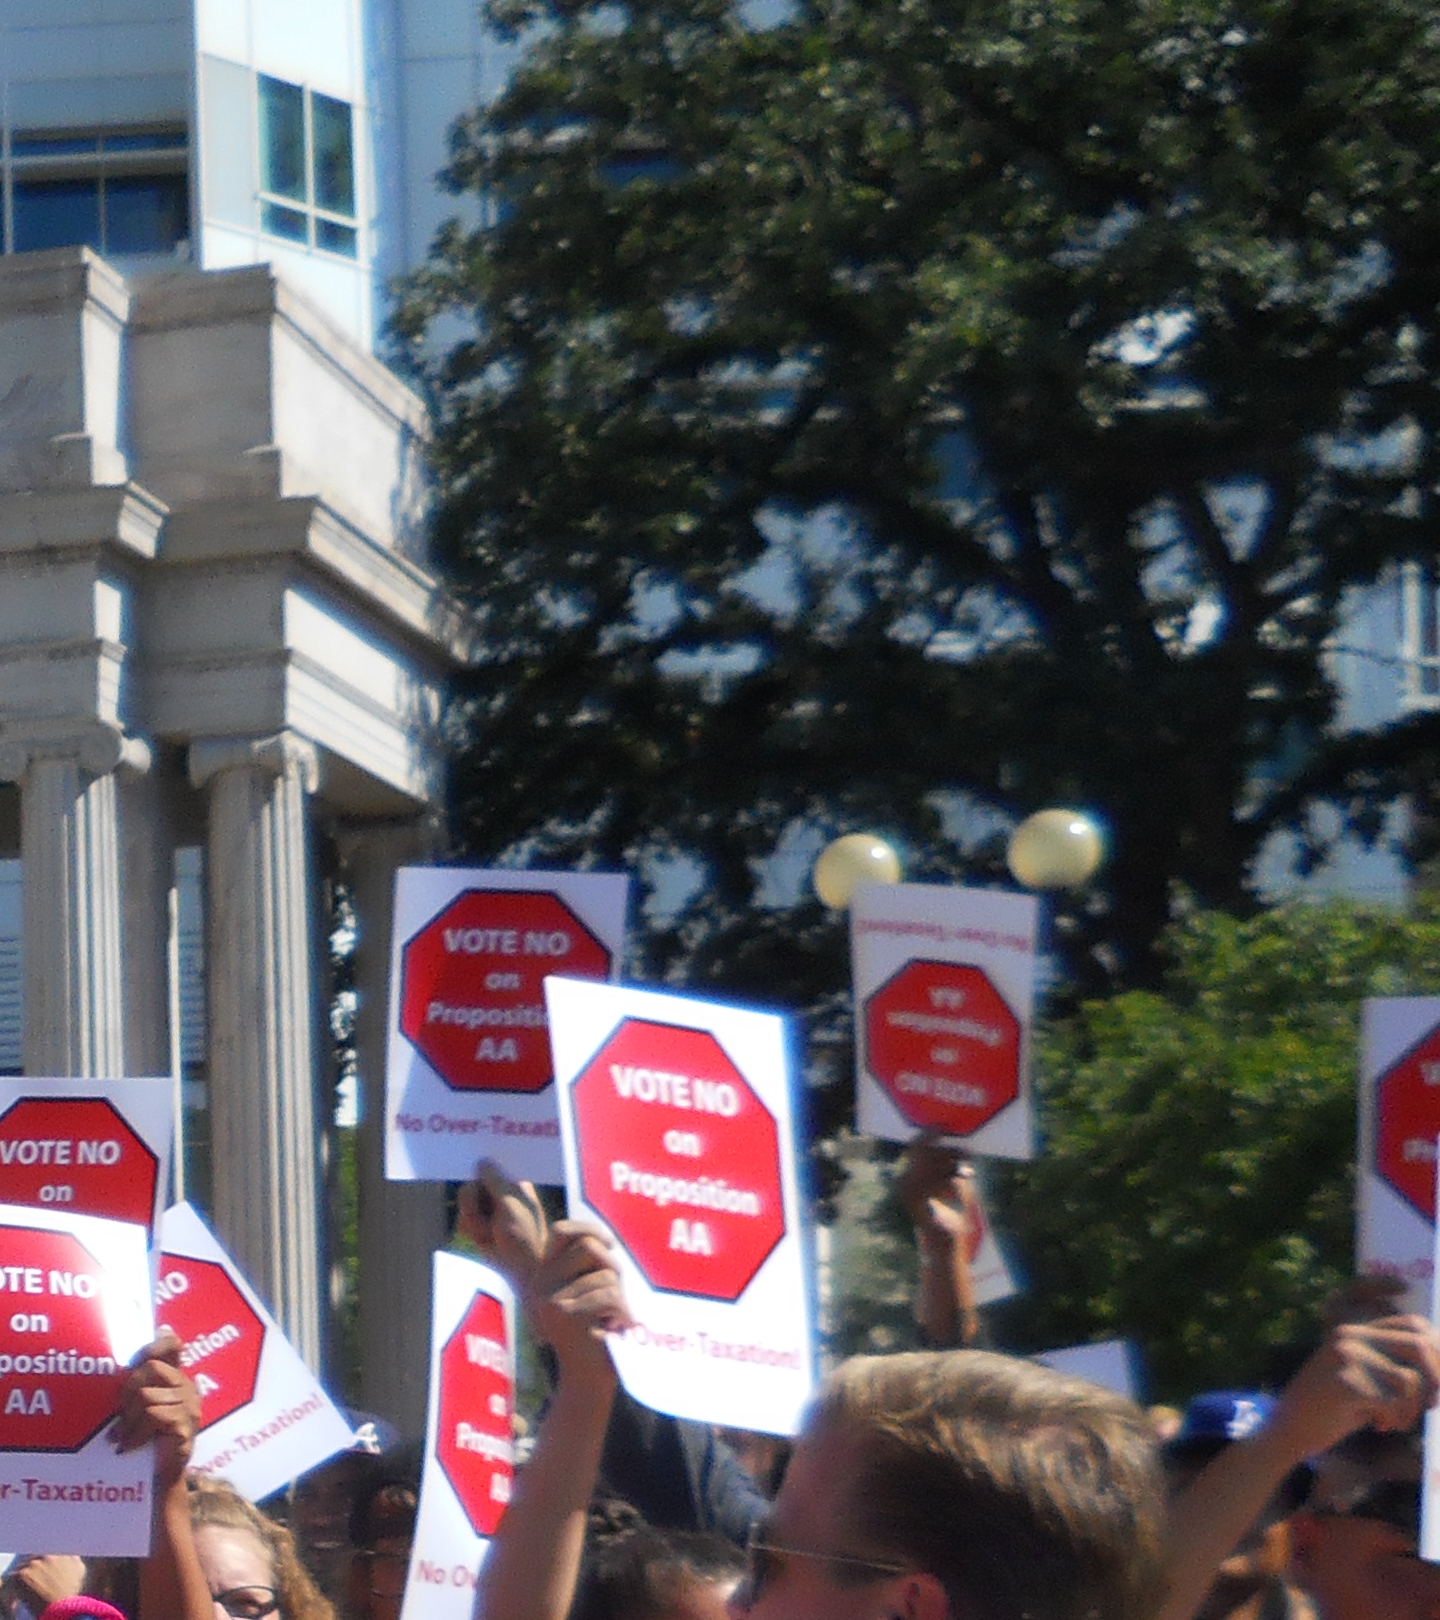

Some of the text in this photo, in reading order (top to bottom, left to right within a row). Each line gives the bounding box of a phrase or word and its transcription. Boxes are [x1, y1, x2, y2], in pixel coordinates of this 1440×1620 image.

[442, 928, 571, 956] VOTE NO
[484, 972, 521, 990] on
[474, 1037, 518, 1062] AA
[609, 1065, 740, 1117] VOTE NO
[396, 1113, 423, 1132] No
[77, 1140, 121, 1165] NO
[662, 1130, 702, 1157] on
[38, 1182, 73, 1202] on
[610, 1161, 761, 1216] Proposition
[669, 1218, 713, 1256] AA
[49, 1272, 100, 1299] NO
[10, 1312, 49, 1334] on
[179, 1324, 241, 1368] sition
[194, 1373, 219, 1396] A
[4, 1388, 52, 1416] AA
[186, 1393, 325, 1474] ver-Taxation!
[417, 1559, 445, 1585] No
